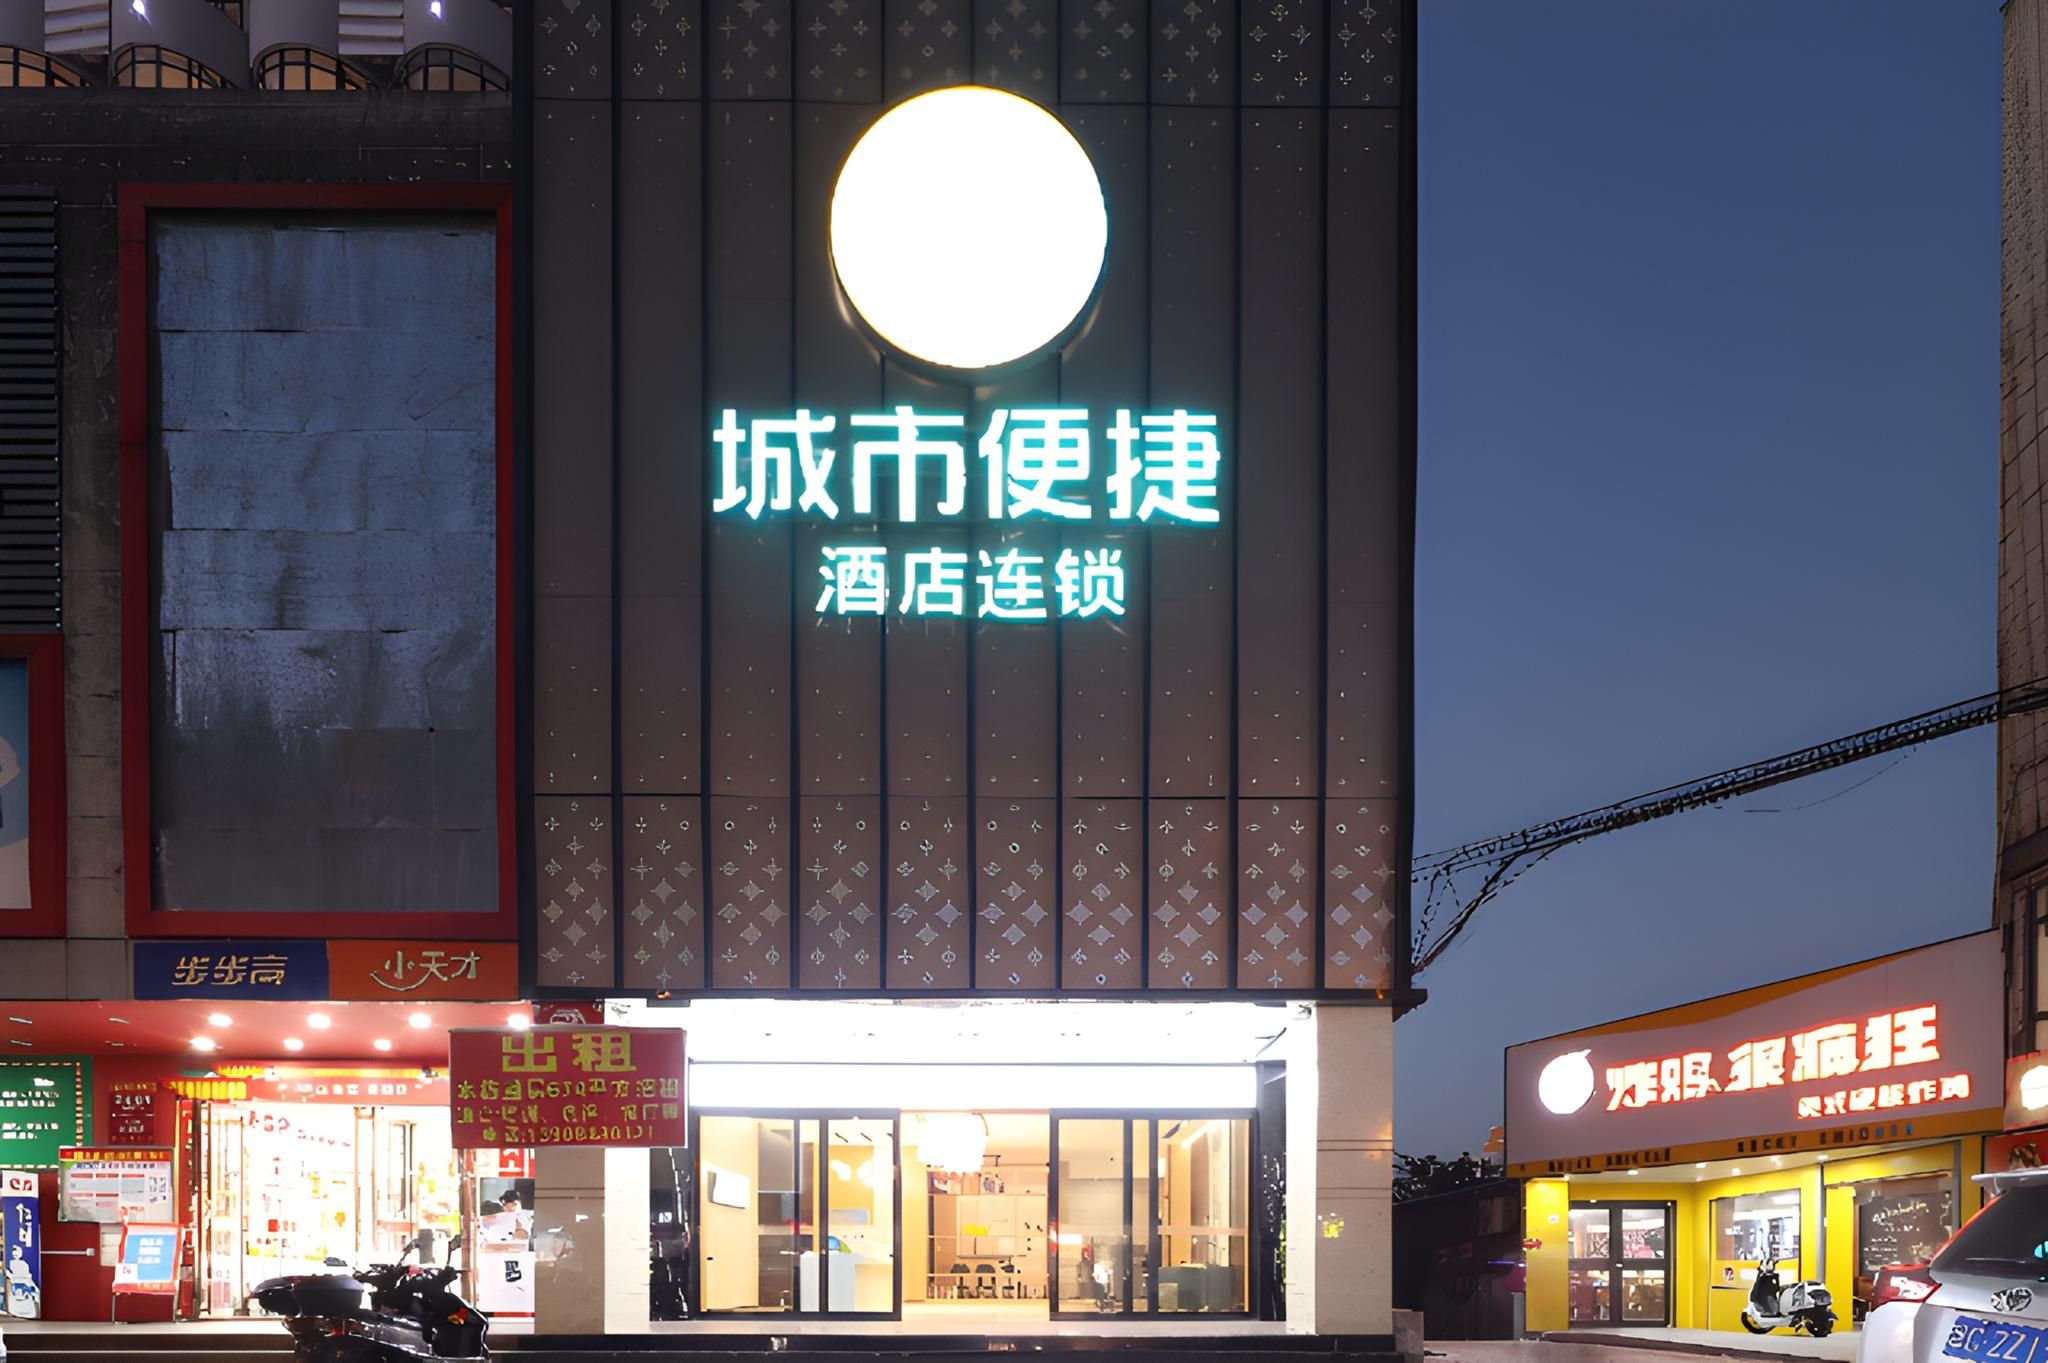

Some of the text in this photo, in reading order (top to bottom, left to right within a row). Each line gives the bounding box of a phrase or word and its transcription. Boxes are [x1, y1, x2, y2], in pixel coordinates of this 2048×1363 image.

[713, 406, 1221, 522] 城市便捷
[816, 546, 1126, 618] 酒店连锁
[171, 953, 289, 986] 步步高
[380, 951, 481, 983] 小天才
[502, 1031, 637, 1073] 出租
